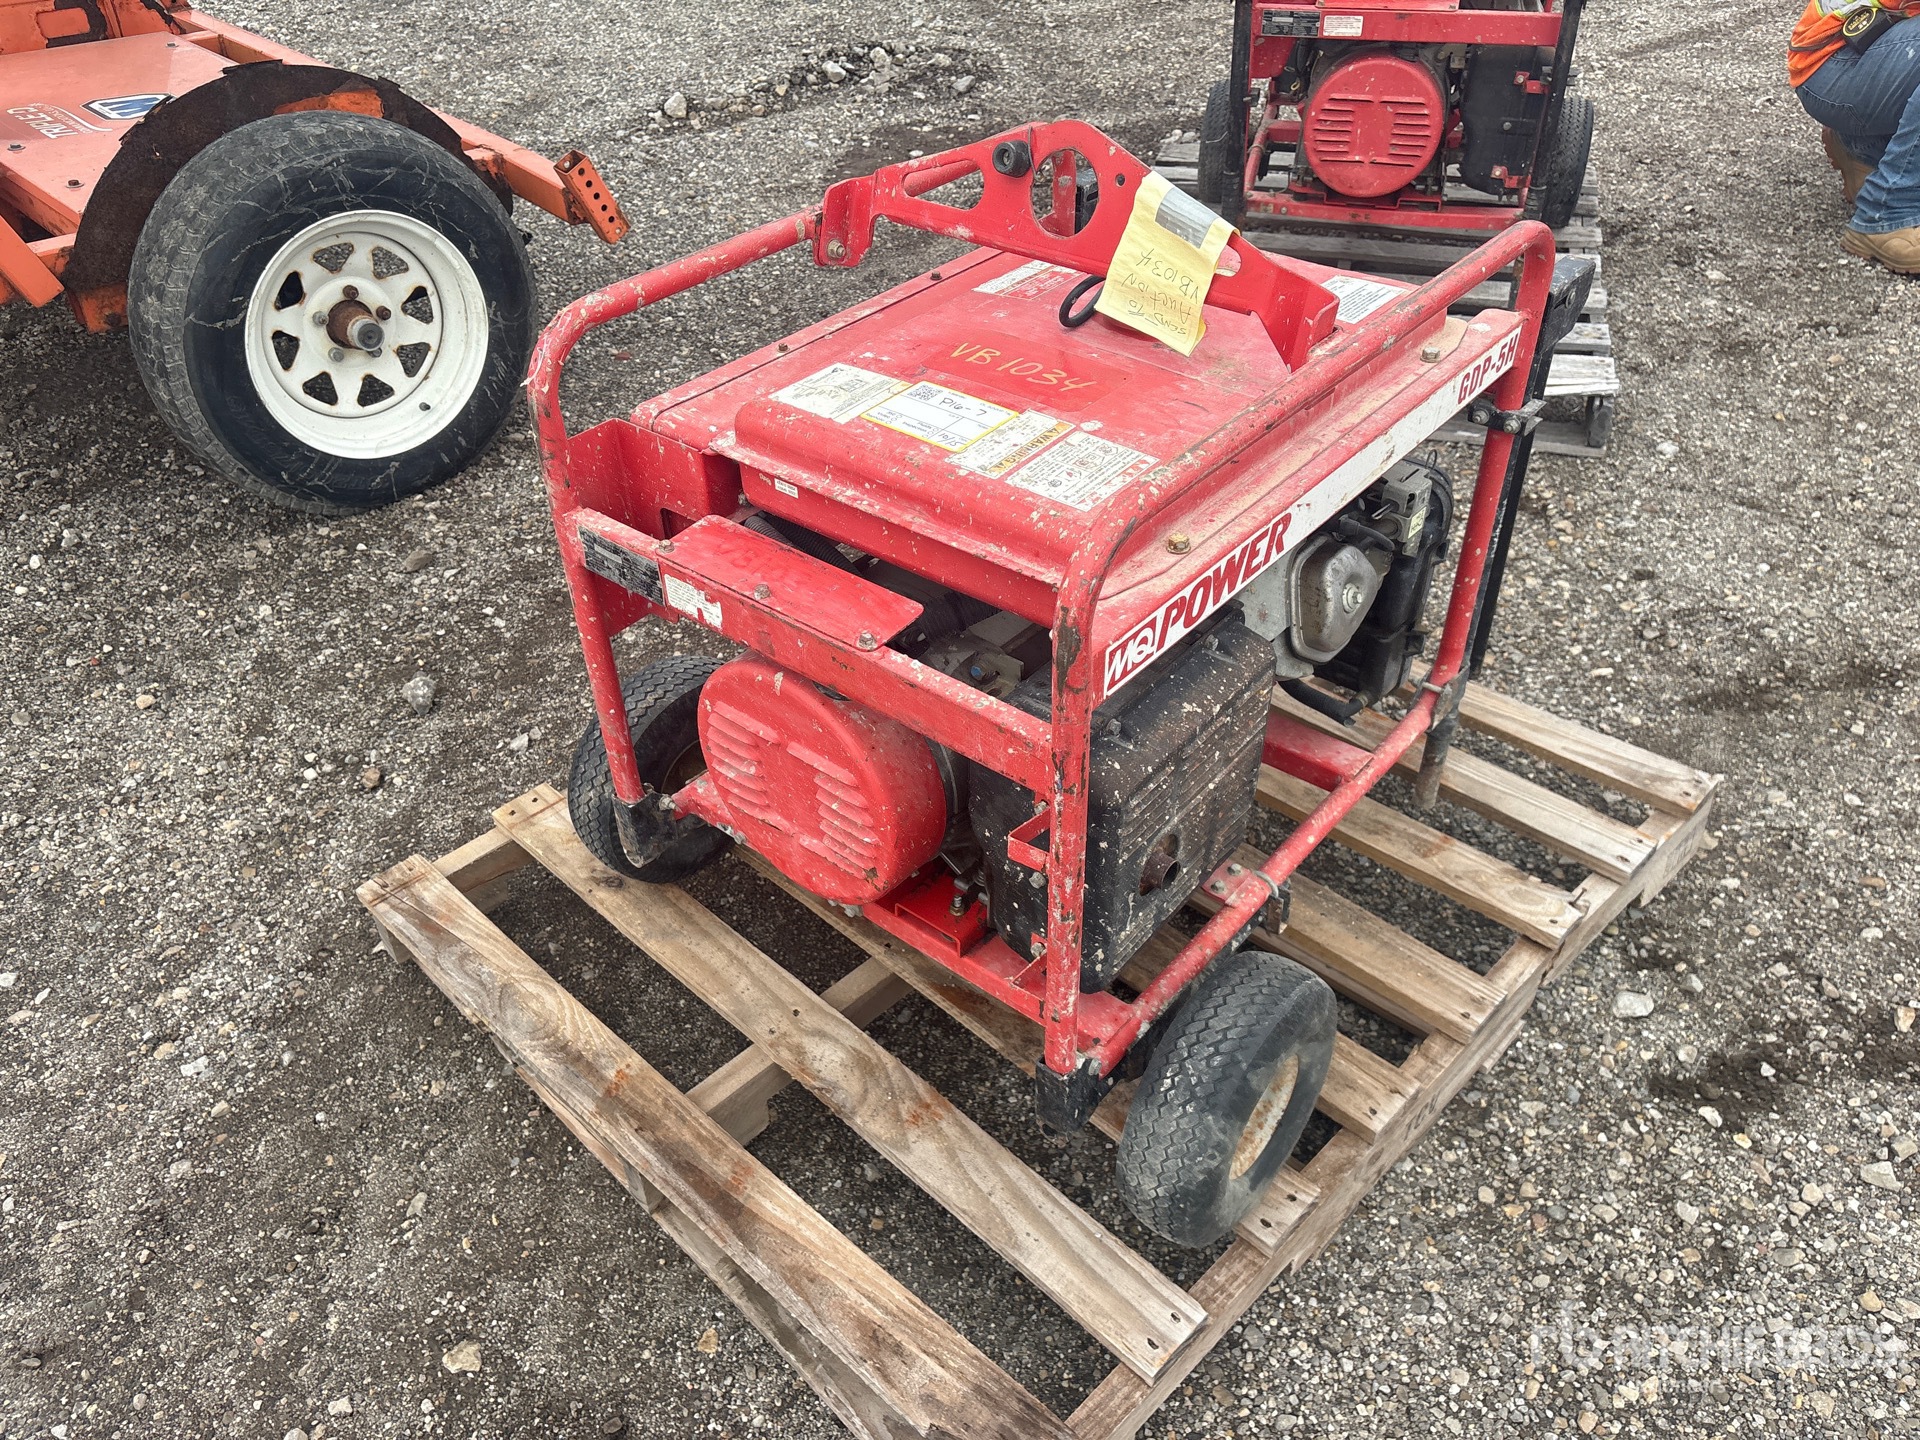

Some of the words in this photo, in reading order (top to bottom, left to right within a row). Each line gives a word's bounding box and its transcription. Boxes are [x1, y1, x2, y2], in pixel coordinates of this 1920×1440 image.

[1136, 248, 1199, 304] VB1034
[951, 342, 1097, 391] VB1034
[1458, 333, 1518, 404] GDP-5H
[1157, 512, 1292, 652] POWER
